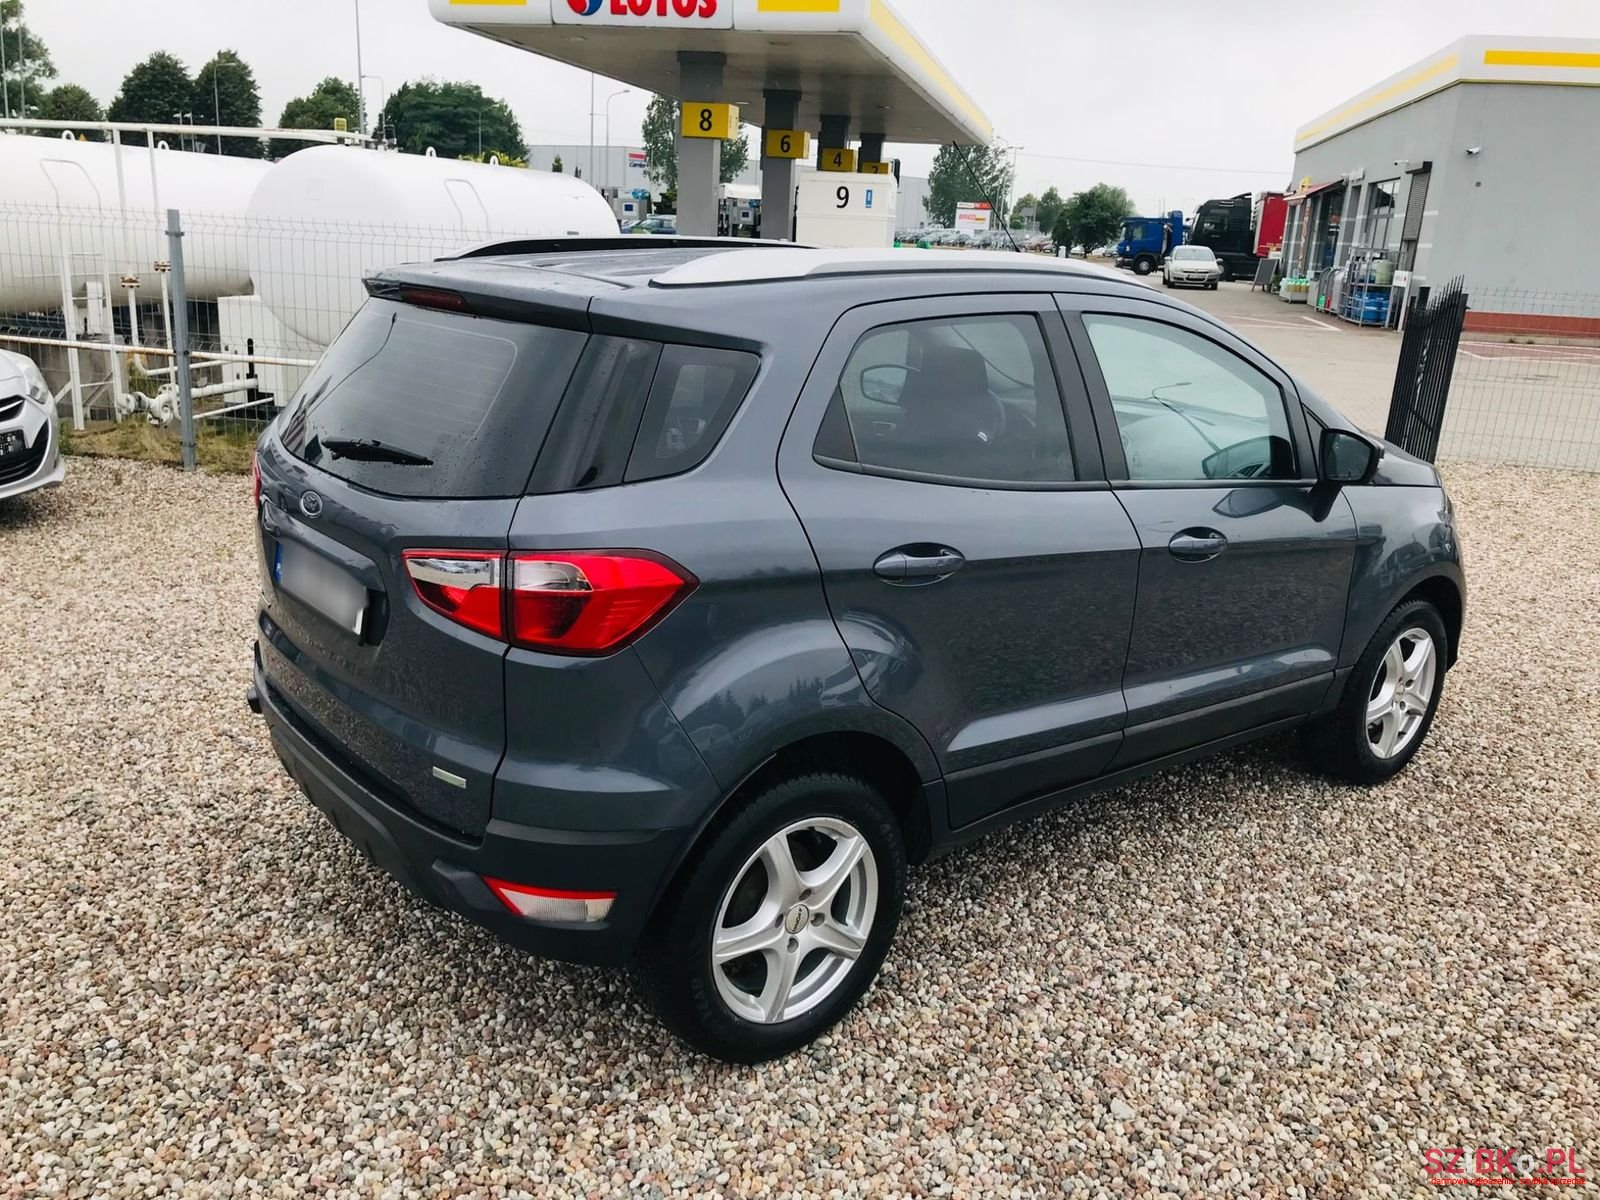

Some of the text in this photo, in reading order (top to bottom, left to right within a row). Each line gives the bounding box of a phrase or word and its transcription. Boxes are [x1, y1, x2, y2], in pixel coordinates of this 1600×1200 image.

[699, 108, 712, 131] 8
[780, 134, 791, 153] 6
[832, 151, 842, 167] 4
[836, 186, 850, 209] 9
